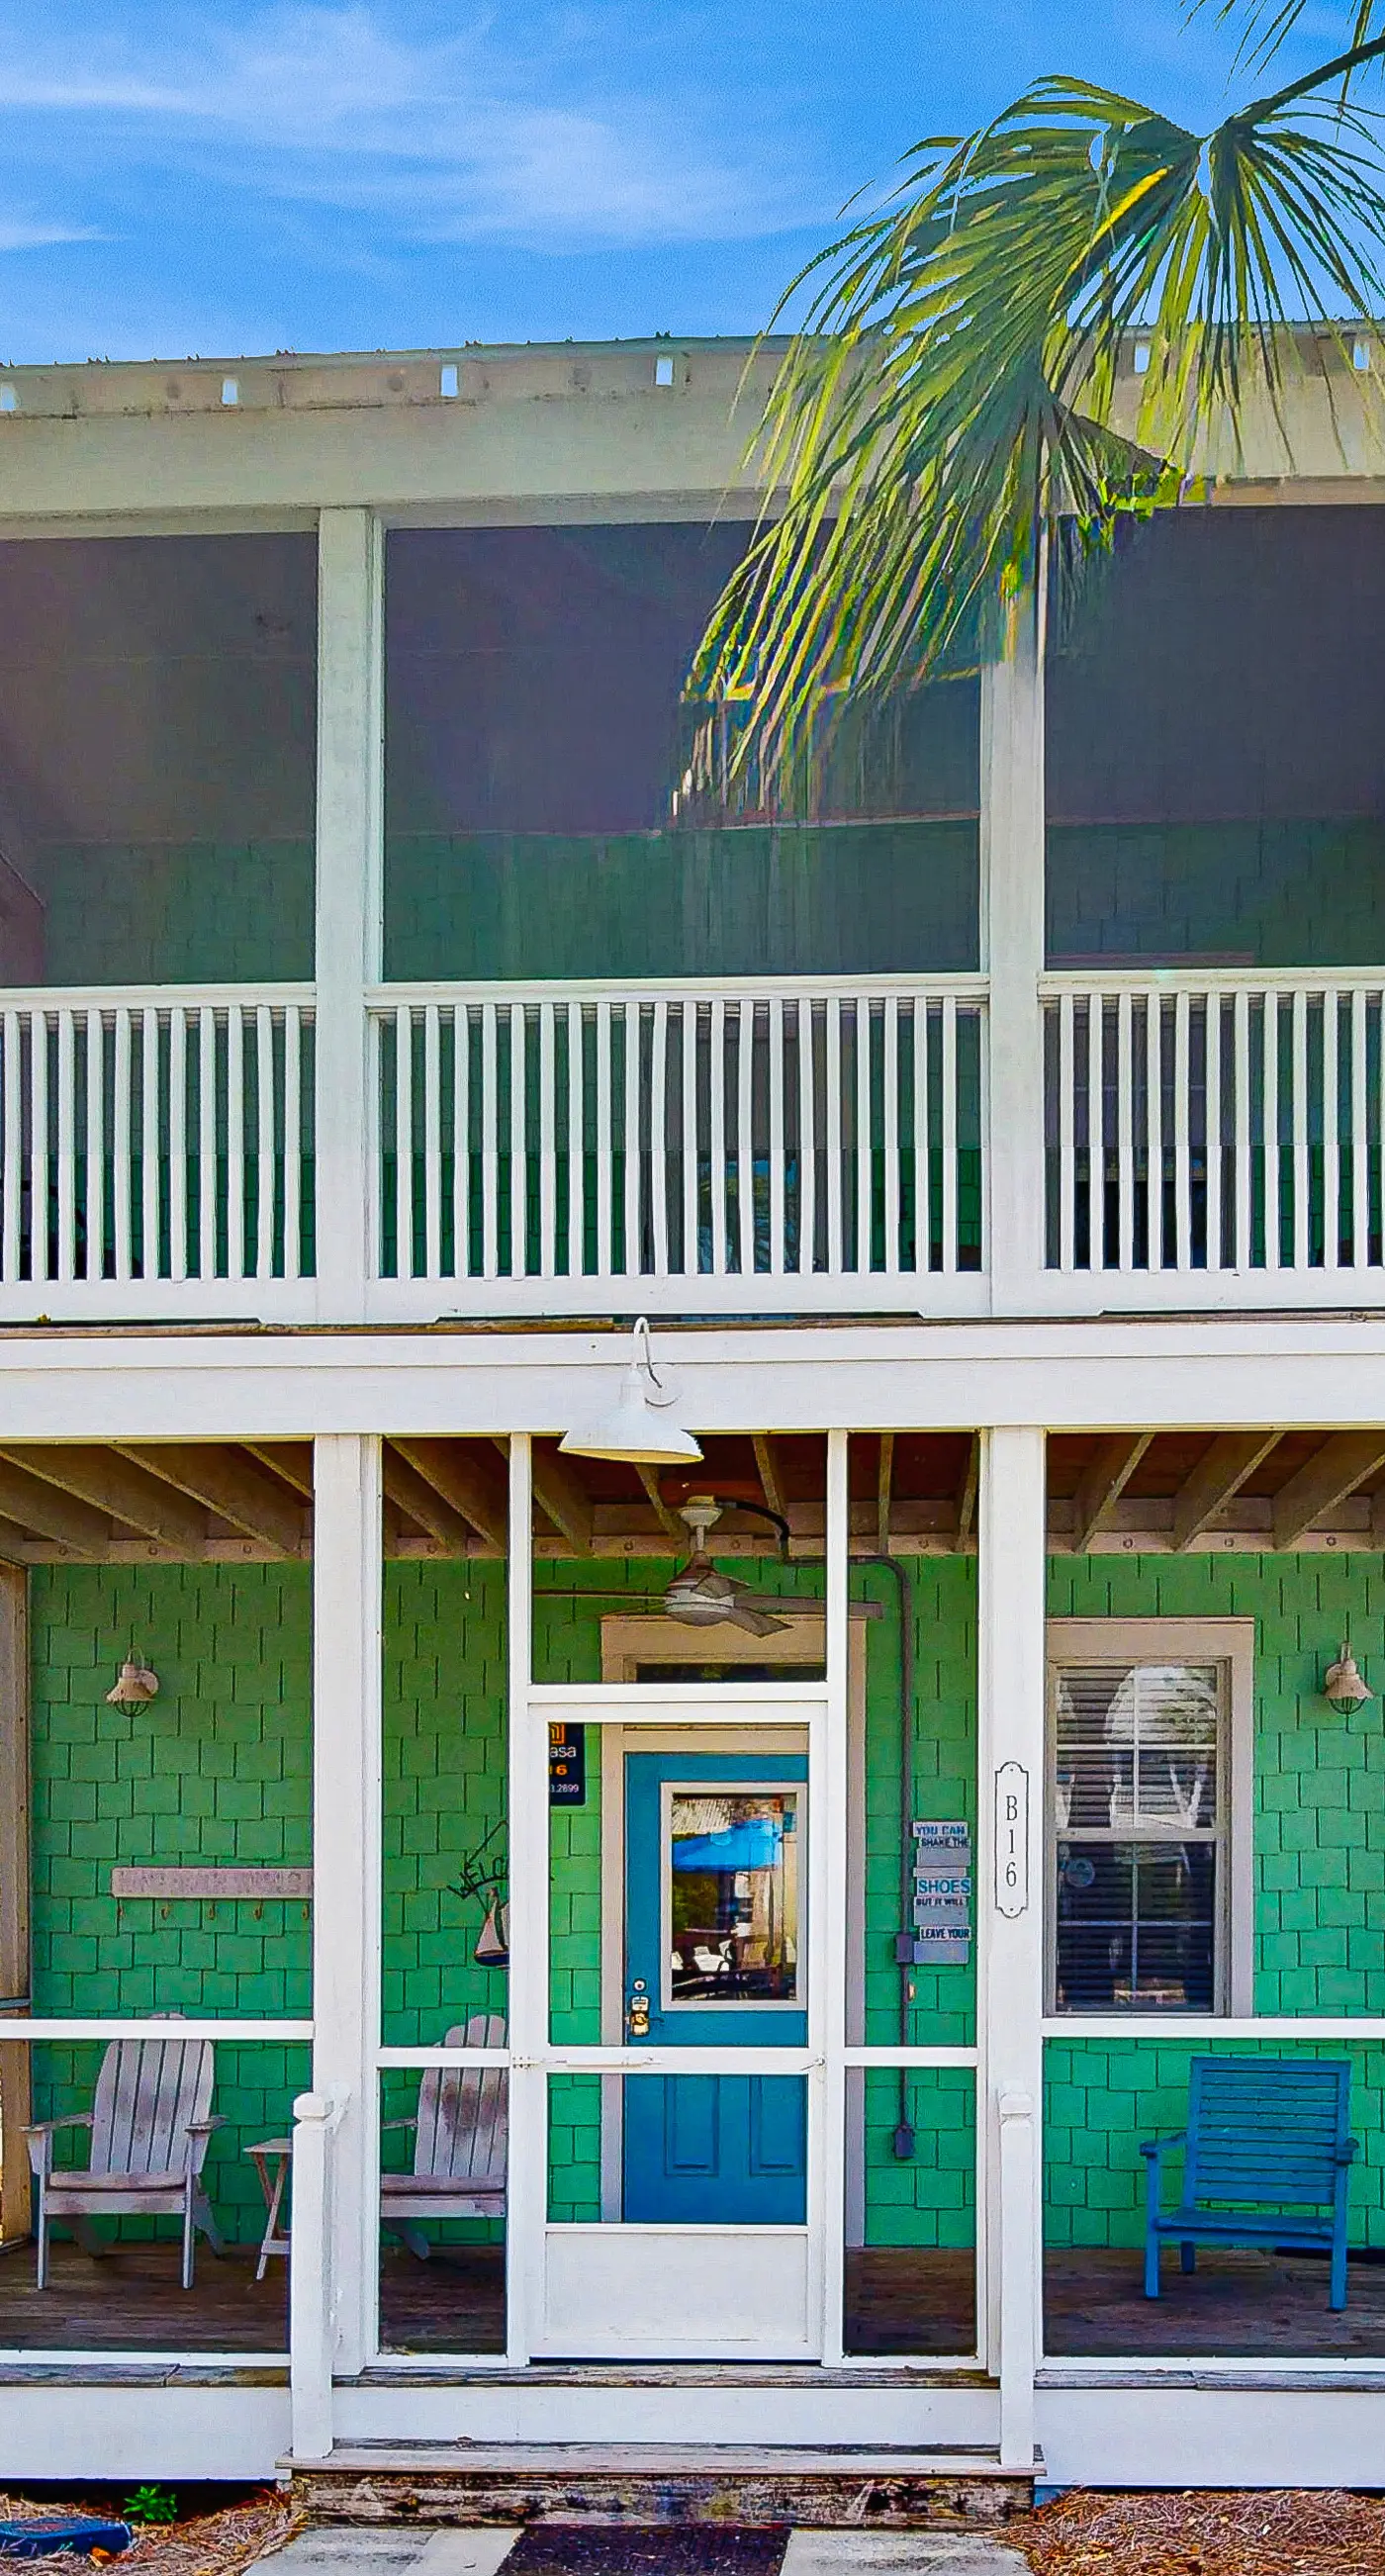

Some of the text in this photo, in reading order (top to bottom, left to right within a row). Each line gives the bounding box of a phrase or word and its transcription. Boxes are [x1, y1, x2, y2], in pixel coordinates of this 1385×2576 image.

[549, 1746, 577, 1758] asa
[916, 1825, 966, 1835] YOU CAN
[921, 1837, 970, 1848] SHAKE THE
[1005, 1794, 1018, 1887] B16
[446, 1856, 509, 1899] WELC
[918, 1879, 970, 1893] SHOES
[916, 1897, 932, 1906] BUT
[934, 1897, 943, 1906] IT
[921, 1928, 970, 1939] LEAVE YOUR
